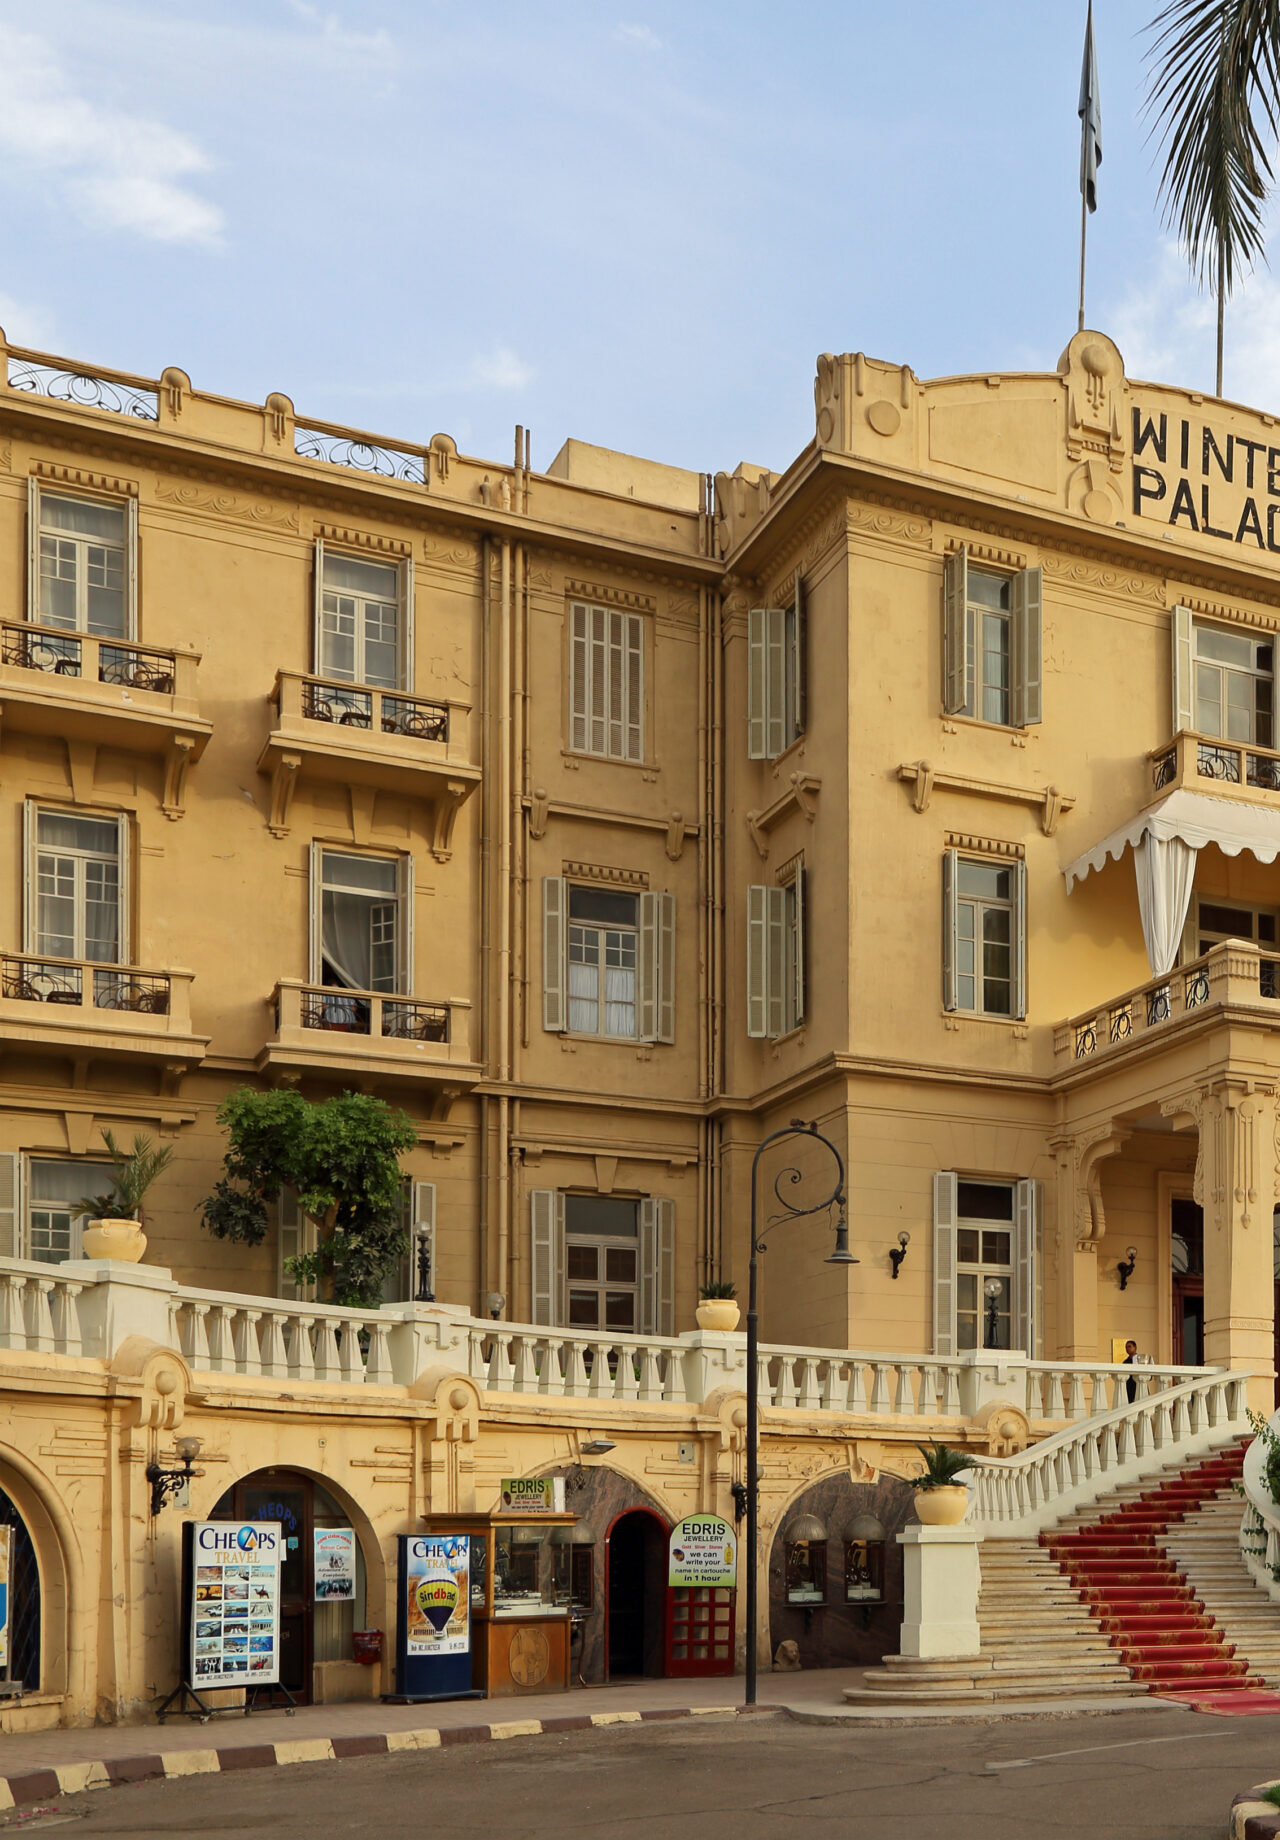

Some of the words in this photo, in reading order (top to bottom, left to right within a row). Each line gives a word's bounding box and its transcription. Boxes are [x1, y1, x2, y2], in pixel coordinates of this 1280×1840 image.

[510, 1480, 545, 1494] EDRIS
[682, 1523, 725, 1535] EDRIS
[199, 1526, 275, 1551] CHEOPS
[215, 1552, 260, 1563] TRAVEL
[426, 1559, 458, 1568] TRAVEL
